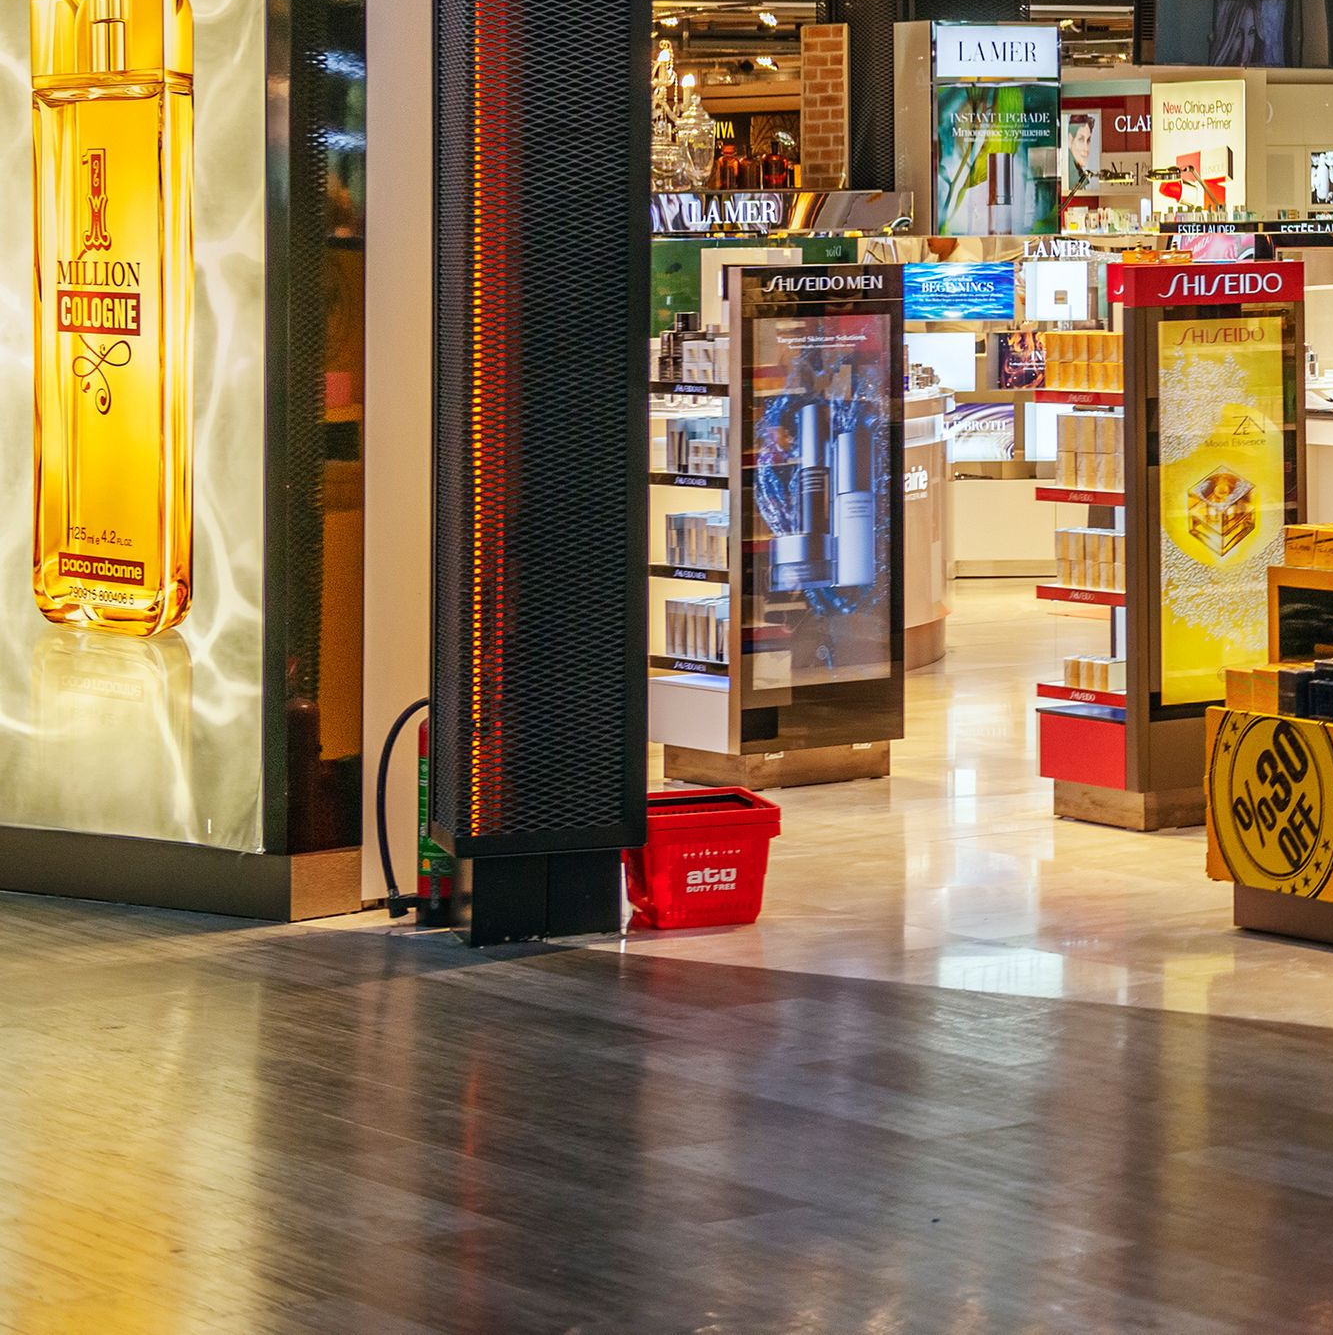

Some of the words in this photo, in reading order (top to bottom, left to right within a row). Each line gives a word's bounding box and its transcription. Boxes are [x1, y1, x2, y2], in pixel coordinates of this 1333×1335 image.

[990, 41, 1038, 62] MER
[950, 113, 998, 124] INSTANT
[998, 112, 1050, 123] UPGRADE
[1162, 101, 1183, 114] New.
[1184, 100, 1215, 117] Clinique
[1216, 99, 1233, 117] Pop
[1163, 118, 1175, 133] Lip
[1176, 117, 1200, 131] Colour
[1207, 117, 1232, 130] Primer
[689, 201, 724, 225] LA
[725, 200, 777, 224] MER
[1202, 224, 1236, 233] LAUDER
[1024, 240, 1053, 258] LA
[1053, 240, 1091, 258] MER
[57, 260, 140, 287] MILLION
[762, 274, 845, 293] SHISEIDO
[847, 275, 884, 290] MEN
[921, 281, 995, 294] BEGINNINGS
[1158, 271, 1283, 299] SHISEIDO
[60, 295, 138, 331] COLOGNE
[1175, 325, 1265, 346] SHISEIDO
[70, 526, 87, 541] 125
[101, 529, 117, 544] 4.2
[61, 557, 91, 574] paco
[92, 560, 143, 580] rabanne
[1231, 718, 1310, 850] %30
[1277, 794, 1320, 872] OFF
[686, 884, 711, 893] DUTY
[713, 882, 737, 892] FREE
